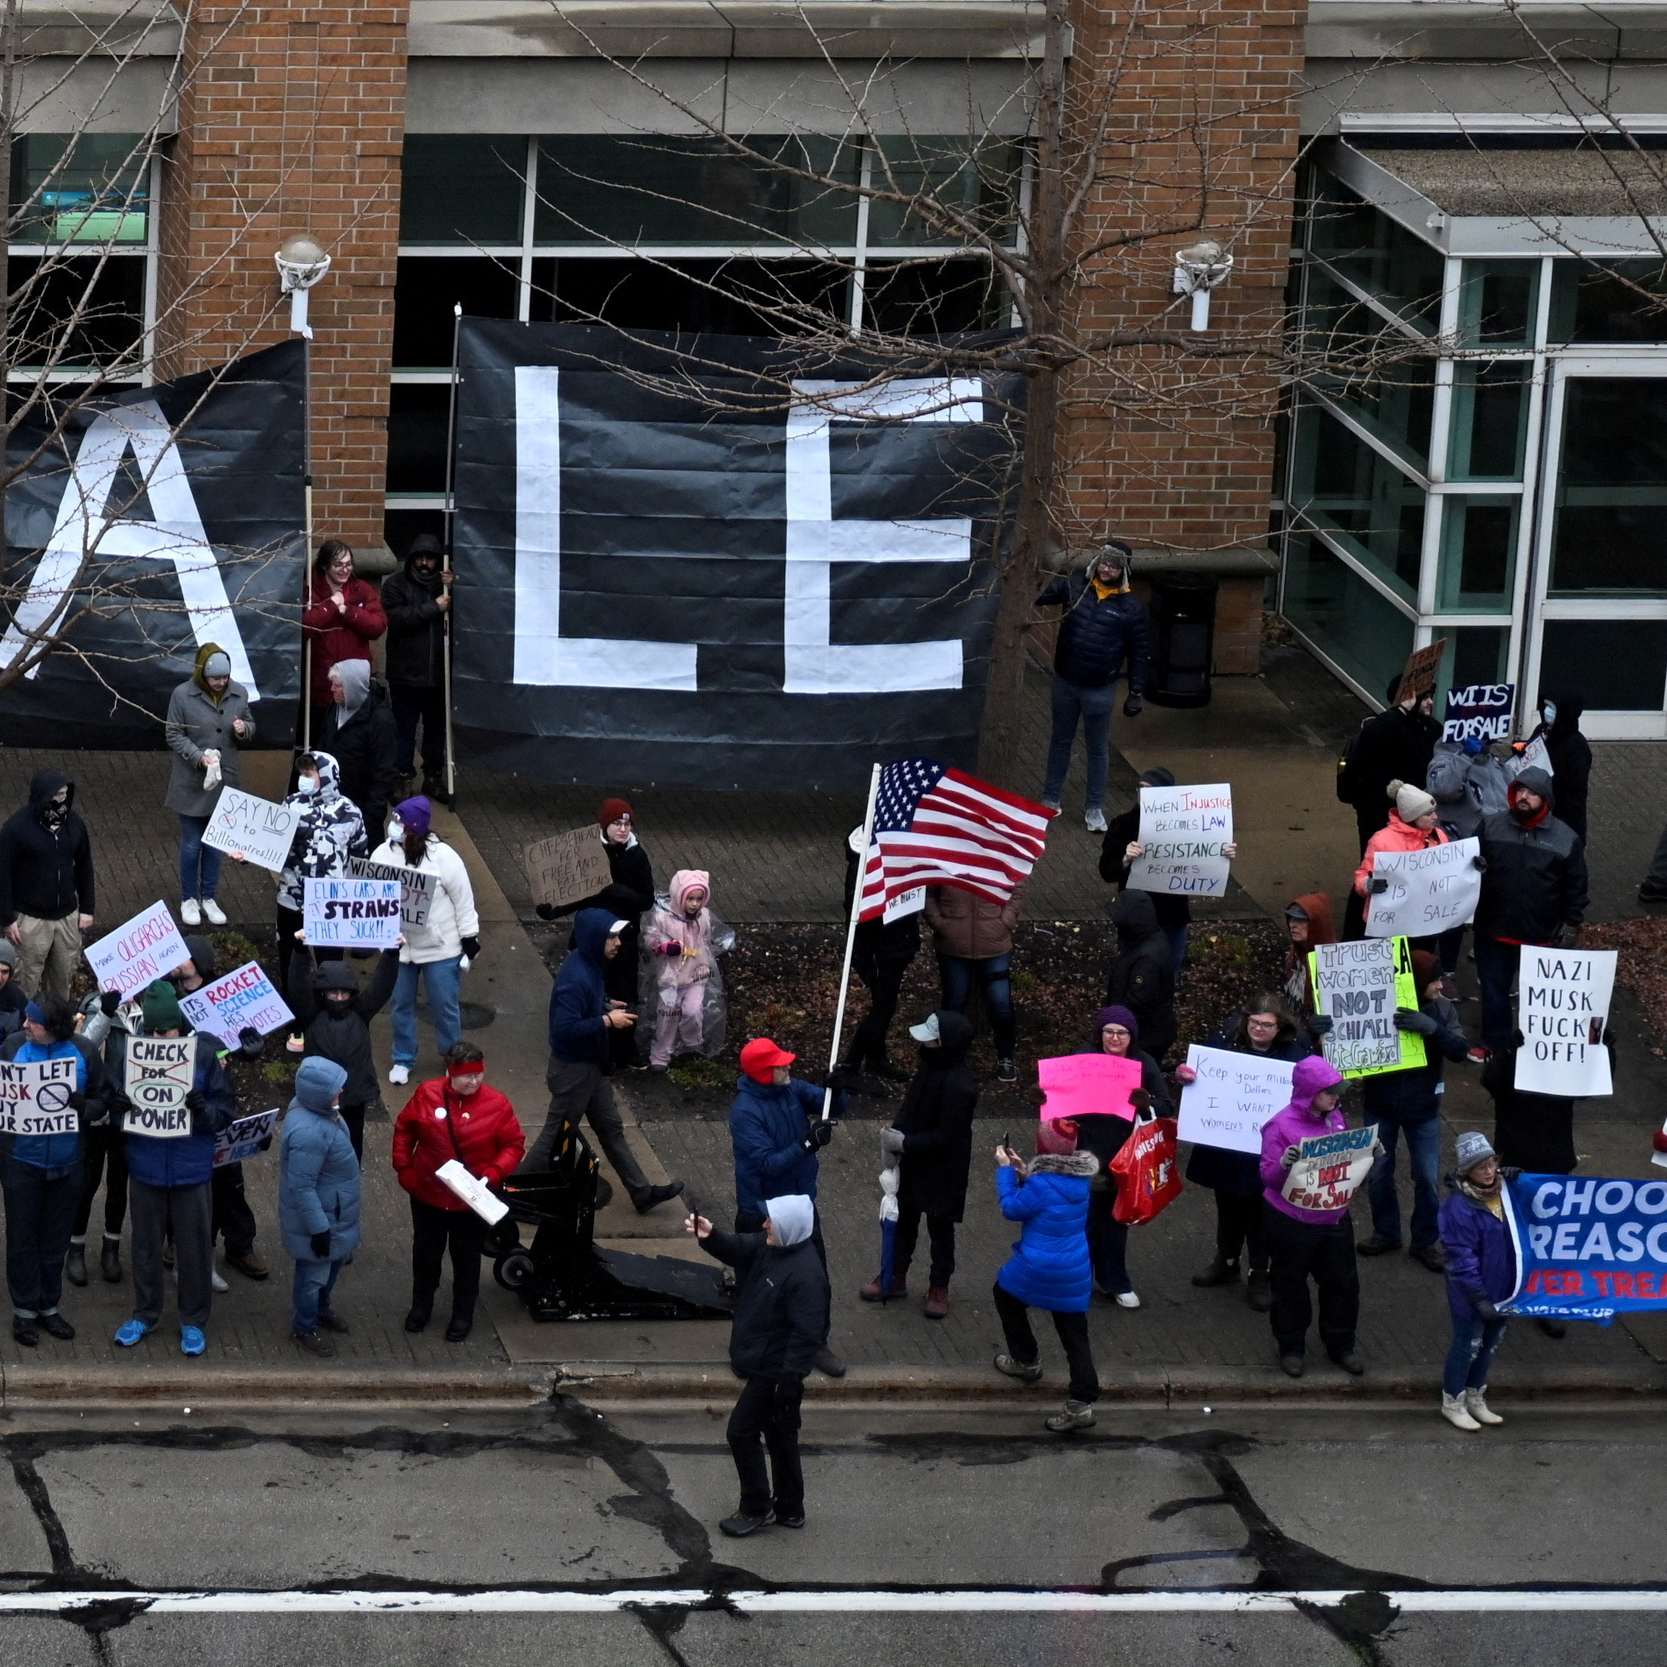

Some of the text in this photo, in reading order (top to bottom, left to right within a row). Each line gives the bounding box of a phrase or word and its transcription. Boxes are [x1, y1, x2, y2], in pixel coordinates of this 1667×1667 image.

[223, 794, 291, 832] SAY NO
[1144, 792, 1230, 813] WHEN INJUSTICE
[1156, 814, 1225, 832] BECOMES LAW
[559, 846, 581, 862] FOR
[1144, 842, 1227, 859] RESISTANCE
[1377, 844, 1465, 873] WISCONSIN
[350, 862, 426, 889] WISCONSIN
[542, 856, 599, 883] FREE AND
[1147, 865, 1200, 874] BECOMES
[354, 883, 376, 898] CARS
[1169, 877, 1219, 892] DUTY
[1392, 875, 1456, 901] IS NOT
[324, 900, 399, 921] STRAWS
[1373, 902, 1460, 924] FOR SALE
[117, 909, 174, 962] OLIGARCHS
[314, 922, 343, 940] THEY
[94, 952, 114, 969] MAKE
[1537, 958, 1590, 981] NAZI
[205, 966, 265, 1006] ROCKET
[216, 980, 273, 1016] SCIENCE
[1332, 989, 1387, 1018] NOT
[1528, 986, 1593, 1012] MUSK
[190, 1011, 209, 1026] NOT
[1528, 1014, 1586, 1038] FUCK
[1325, 1018, 1391, 1043] SCHIMEL
[133, 1041, 189, 1062] CHECK
[1535, 1041, 1585, 1063] OFF!
[39, 1060, 75, 1081] LET
[141, 1067, 166, 1079] FOR
[143, 1087, 174, 1102] ON
[22, 1114, 76, 1133] STATE
[129, 1108, 187, 1130] POWER
[1305, 1160, 1352, 1186] IS NOT
[1288, 1185, 1322, 1208] FOR
